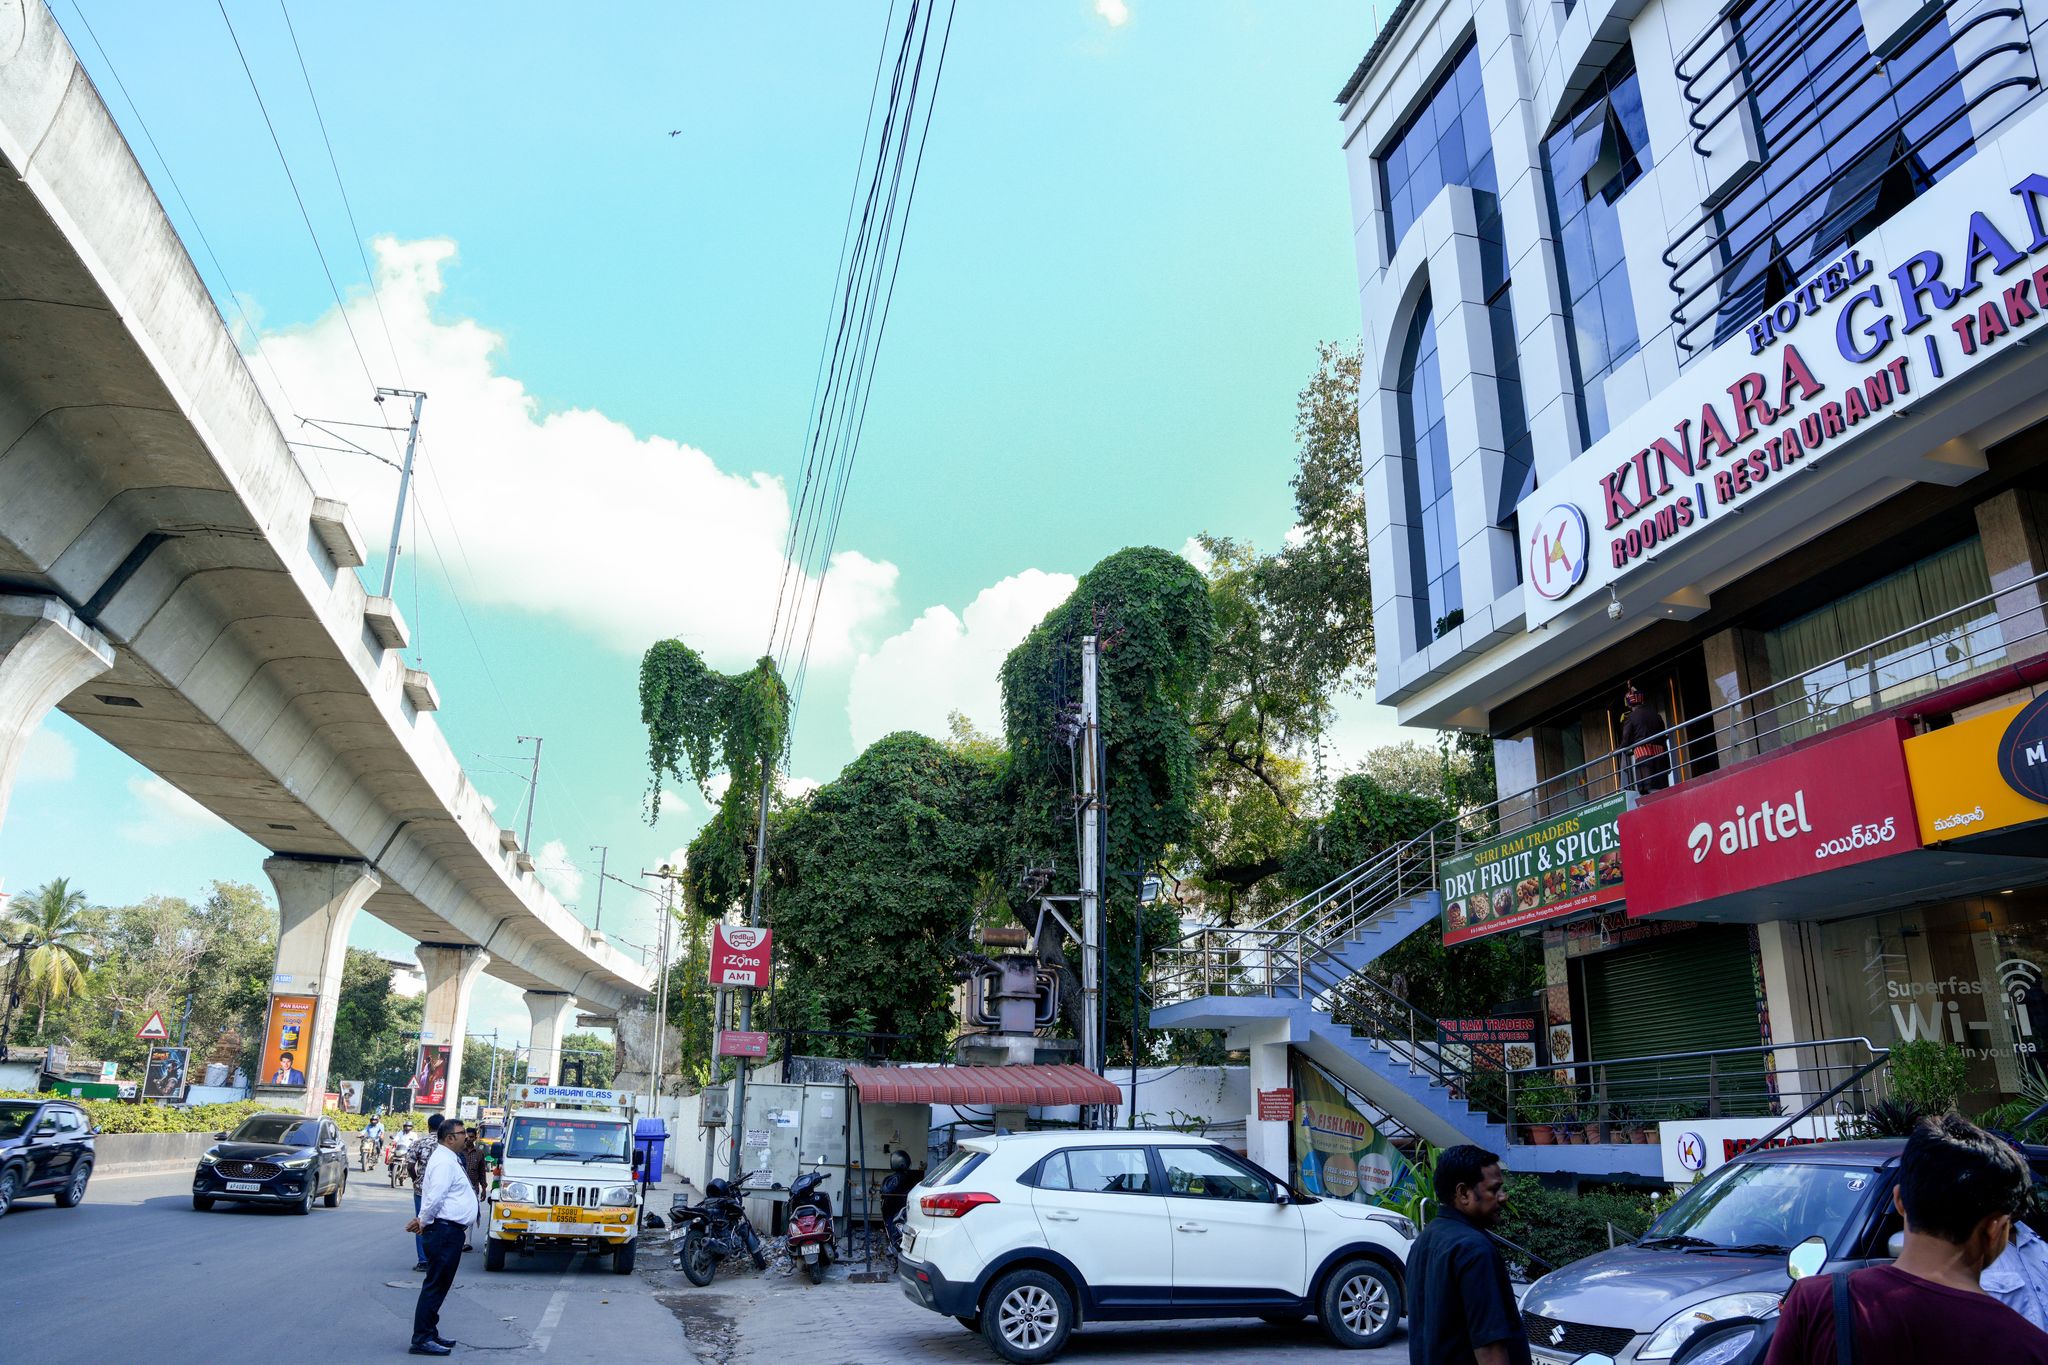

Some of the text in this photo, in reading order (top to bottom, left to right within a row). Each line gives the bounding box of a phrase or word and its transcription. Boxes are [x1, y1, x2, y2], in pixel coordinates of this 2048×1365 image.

[1746, 250, 1874, 356] HOTEL
[1599, 343, 1825, 530] KINARA
[1611, 496, 1695, 569] ROOMS
[1714, 355, 1909, 504] RESTAURANT
[1719, 789, 1813, 855] airtel
[1474, 847, 1498, 867] SHRI
[1501, 837, 1525, 860] RAM
[1525, 817, 1580, 850] TRADERS
[1444, 871, 1477, 901] DRY
[1480, 850, 1533, 891] FRUIT
[1537, 845, 1553, 872] &
[731, 933, 755, 941] redBus
[1887, 976, 1992, 998] Superfast
[1439, 1018, 1535, 1031] SRI RAM TRADERS
[1463, 1032, 1488, 1041] FRUITS
[533, 1087, 613, 1099] SRI BHAVANI GLASS
[1317, 1113, 1365, 1137] FISHLAND
[1373, 1167, 1390, 1176] DOOR
